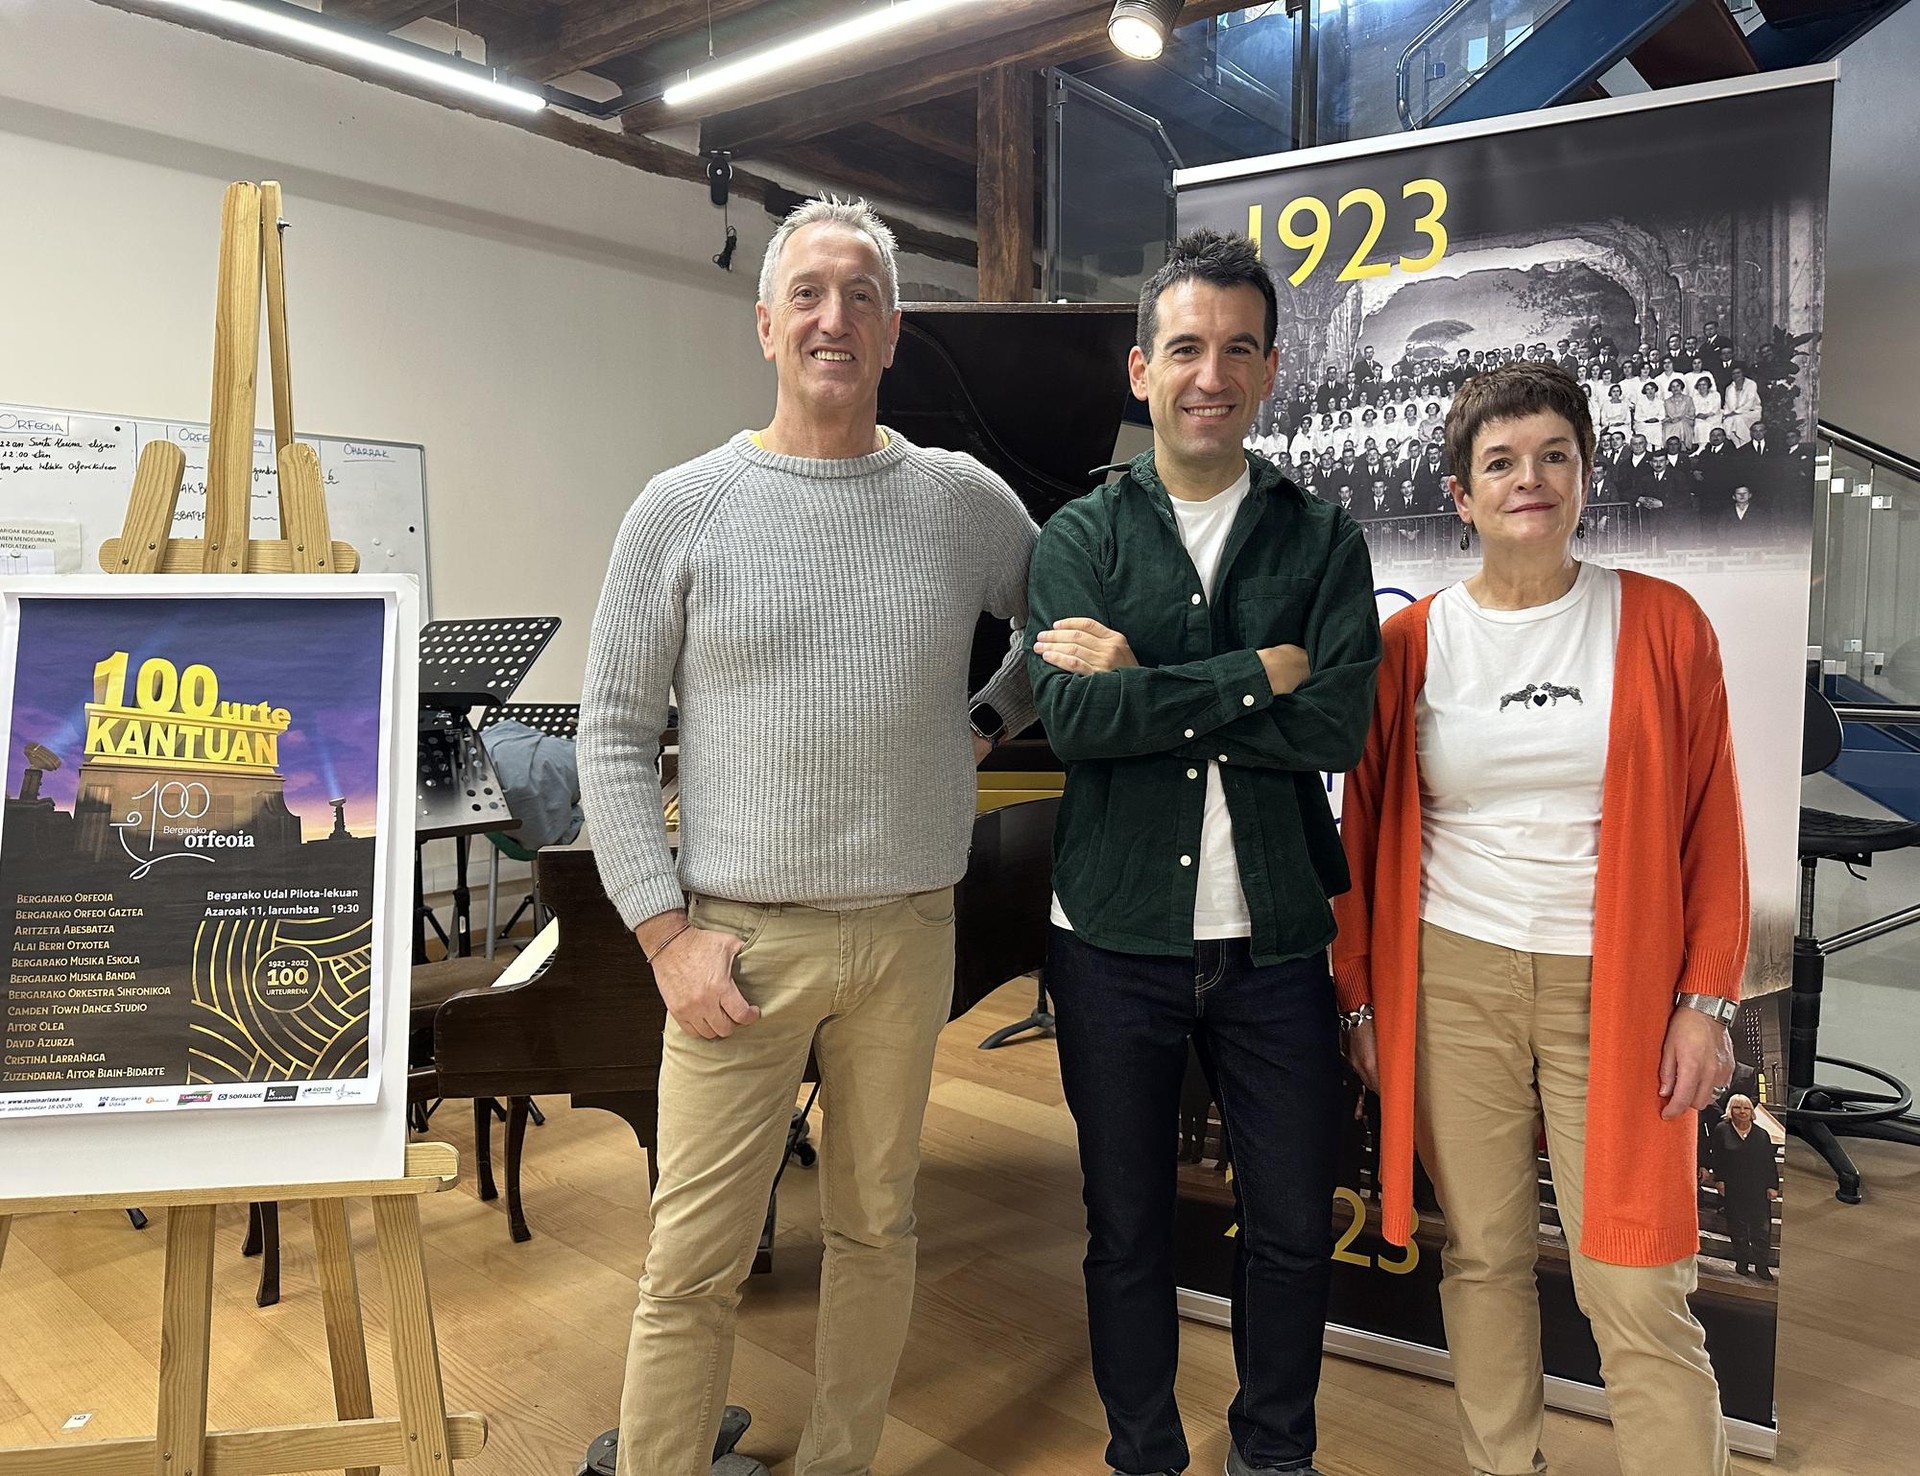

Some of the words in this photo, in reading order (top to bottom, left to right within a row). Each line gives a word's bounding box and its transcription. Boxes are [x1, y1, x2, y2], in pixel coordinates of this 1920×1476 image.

[1248, 178, 1448, 288] 1923
[93, 650, 219, 718] 100
[218, 700, 292, 727] urte
[85, 717, 279, 765] KANTUAN
[163, 826, 206, 836] Bergarako
[184, 830, 255, 848] orfeoia
[16, 893, 73, 904] BERGARAKO
[74, 892, 114, 903] ORFEOIA
[206, 890, 261, 903] Bergarako
[263, 889, 288, 899] Udal
[290, 888, 359, 899] Pilota-lekuan
[15, 910, 72, 920] BERGARAKO
[73, 908, 107, 919] ORFEOI
[108, 907, 144, 917] GAZTEA
[204, 906, 249, 917] Azaroak
[251, 906, 266, 917] 11,
[268, 905, 320, 916] larunbata
[331, 904, 360, 914] 19:30
[14, 925, 61, 936] ARITZETA
[63, 924, 115, 935] ABESBATZA
[13, 942, 36, 952] ALAI
[38, 941, 65, 951] BERRI
[66, 940, 110, 950] OTXOTEA
[11, 957, 68, 968] BERGARAKO
[70, 956, 104, 966] MUSIKA
[106, 955, 141, 965] ESKOLA
[268, 960, 286, 968] 1923
[291, 959, 309, 967] 2023
[10, 973, 67, 984] BERGARAKO
[69, 972, 103, 982] MUSIKA
[105, 971, 137, 981] BANDA
[266, 967, 309, 986] 100
[8, 989, 66, 1000] BERGARAKO
[68, 988, 115, 999] ORKESTRA
[116, 986, 172, 997] SINFONIKOA
[266, 988, 309, 996] URTEURRENA
[7, 1006, 49, 1016] CAMDEN
[52, 1005, 80, 1015] TOWN
[82, 1003, 112, 1014] DANCE
[113, 1002, 148, 1013] STUDIO
[7, 1022, 37, 1032] AITOR
[39, 1021, 65, 1031] OLEA
[5, 1038, 35, 1049] DAVID
[37, 1037, 75, 1048] AZURZA
[4, 1054, 48, 1065] CRISTINA
[50, 1052, 106, 1064] LARRAÑAGA
[2, 1071, 65, 1082] ZUZENDARIA:
[66, 1069, 96, 1080] AITOR
[97, 1067, 166, 1078] BIAIN-BIDARTE
